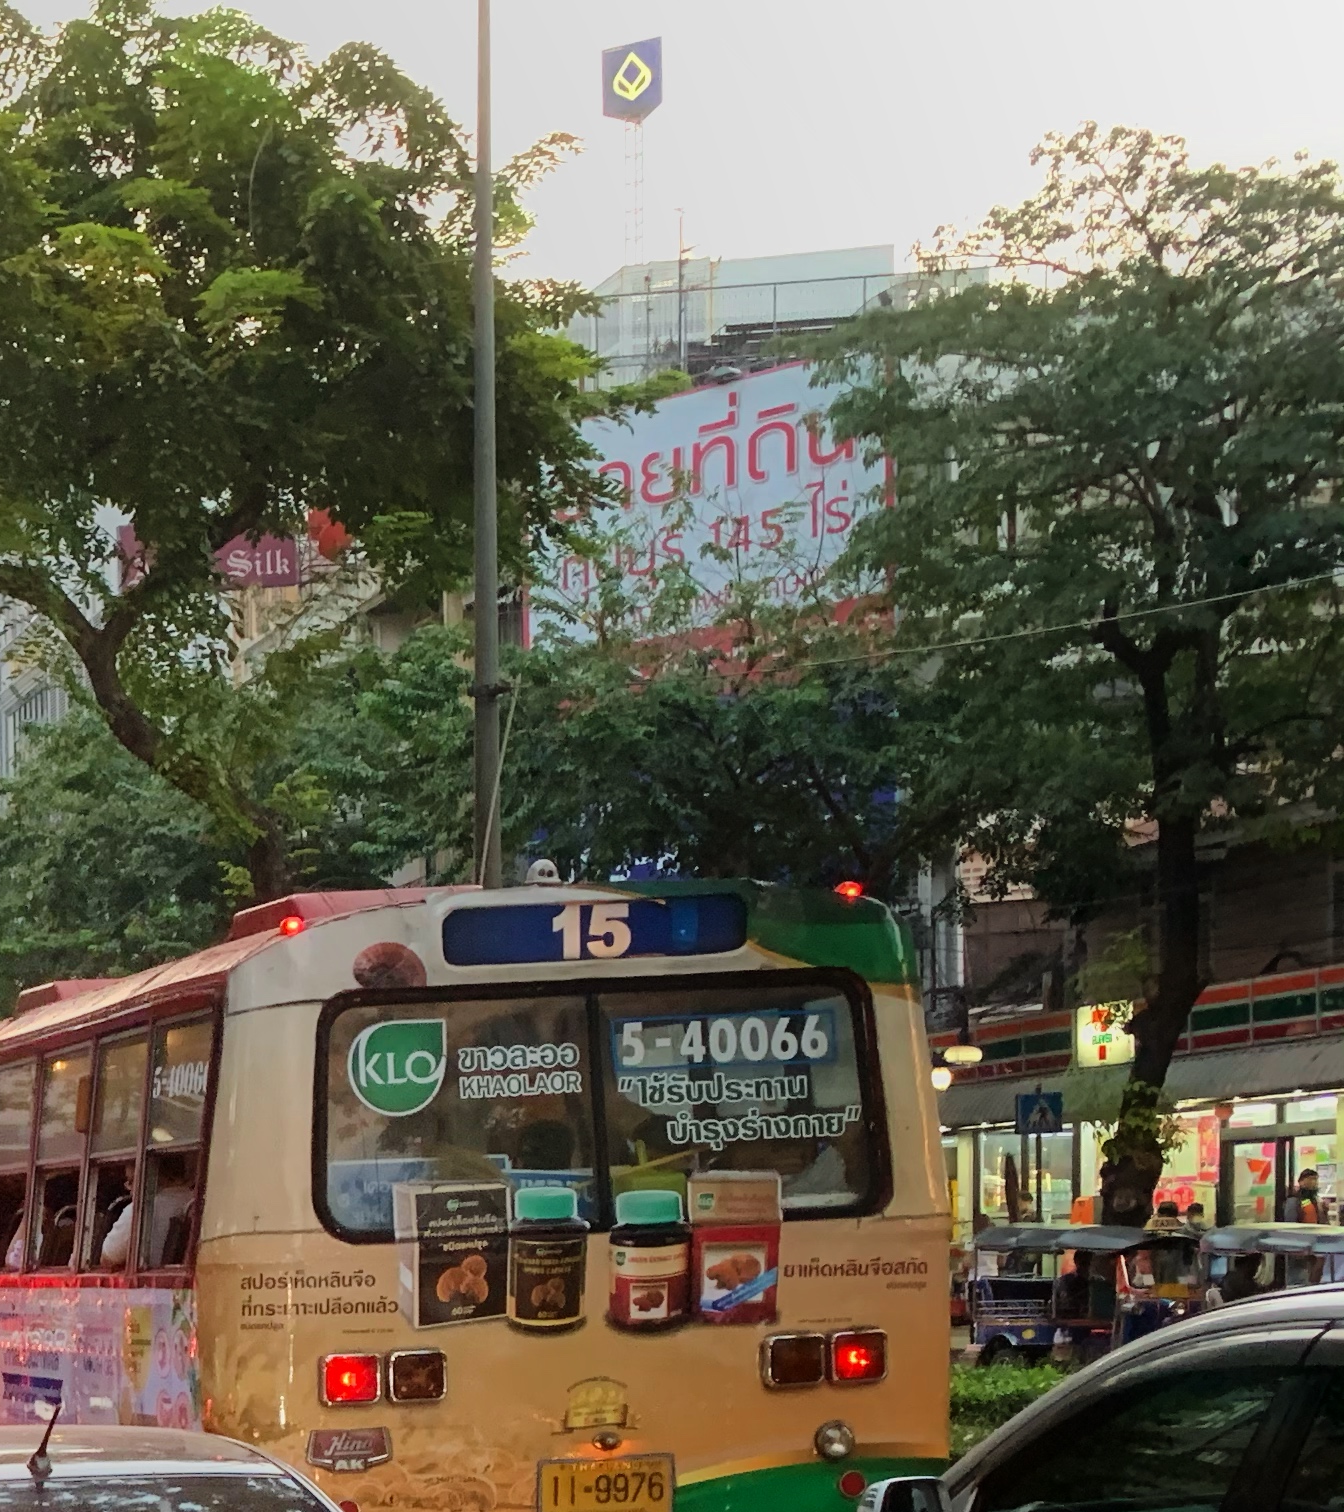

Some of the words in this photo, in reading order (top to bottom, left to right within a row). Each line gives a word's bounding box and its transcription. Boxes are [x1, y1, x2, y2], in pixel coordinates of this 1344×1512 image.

[554, 391, 854, 522] ายที่ดิน
[710, 508, 784, 552] 145
[807, 480, 852, 537] ไร่
[226, 549, 291, 578] Silk
[552, 903, 630, 959] 15
[359, 1051, 445, 1087] KLO
[459, 1044, 579, 1072] ขาวละออ
[459, 1073, 582, 1099] KHAOLAOR
[783, 1257, 928, 1277] ยาเห็ดหลินจือสกัด
[335, 1459, 365, 1470] AK
